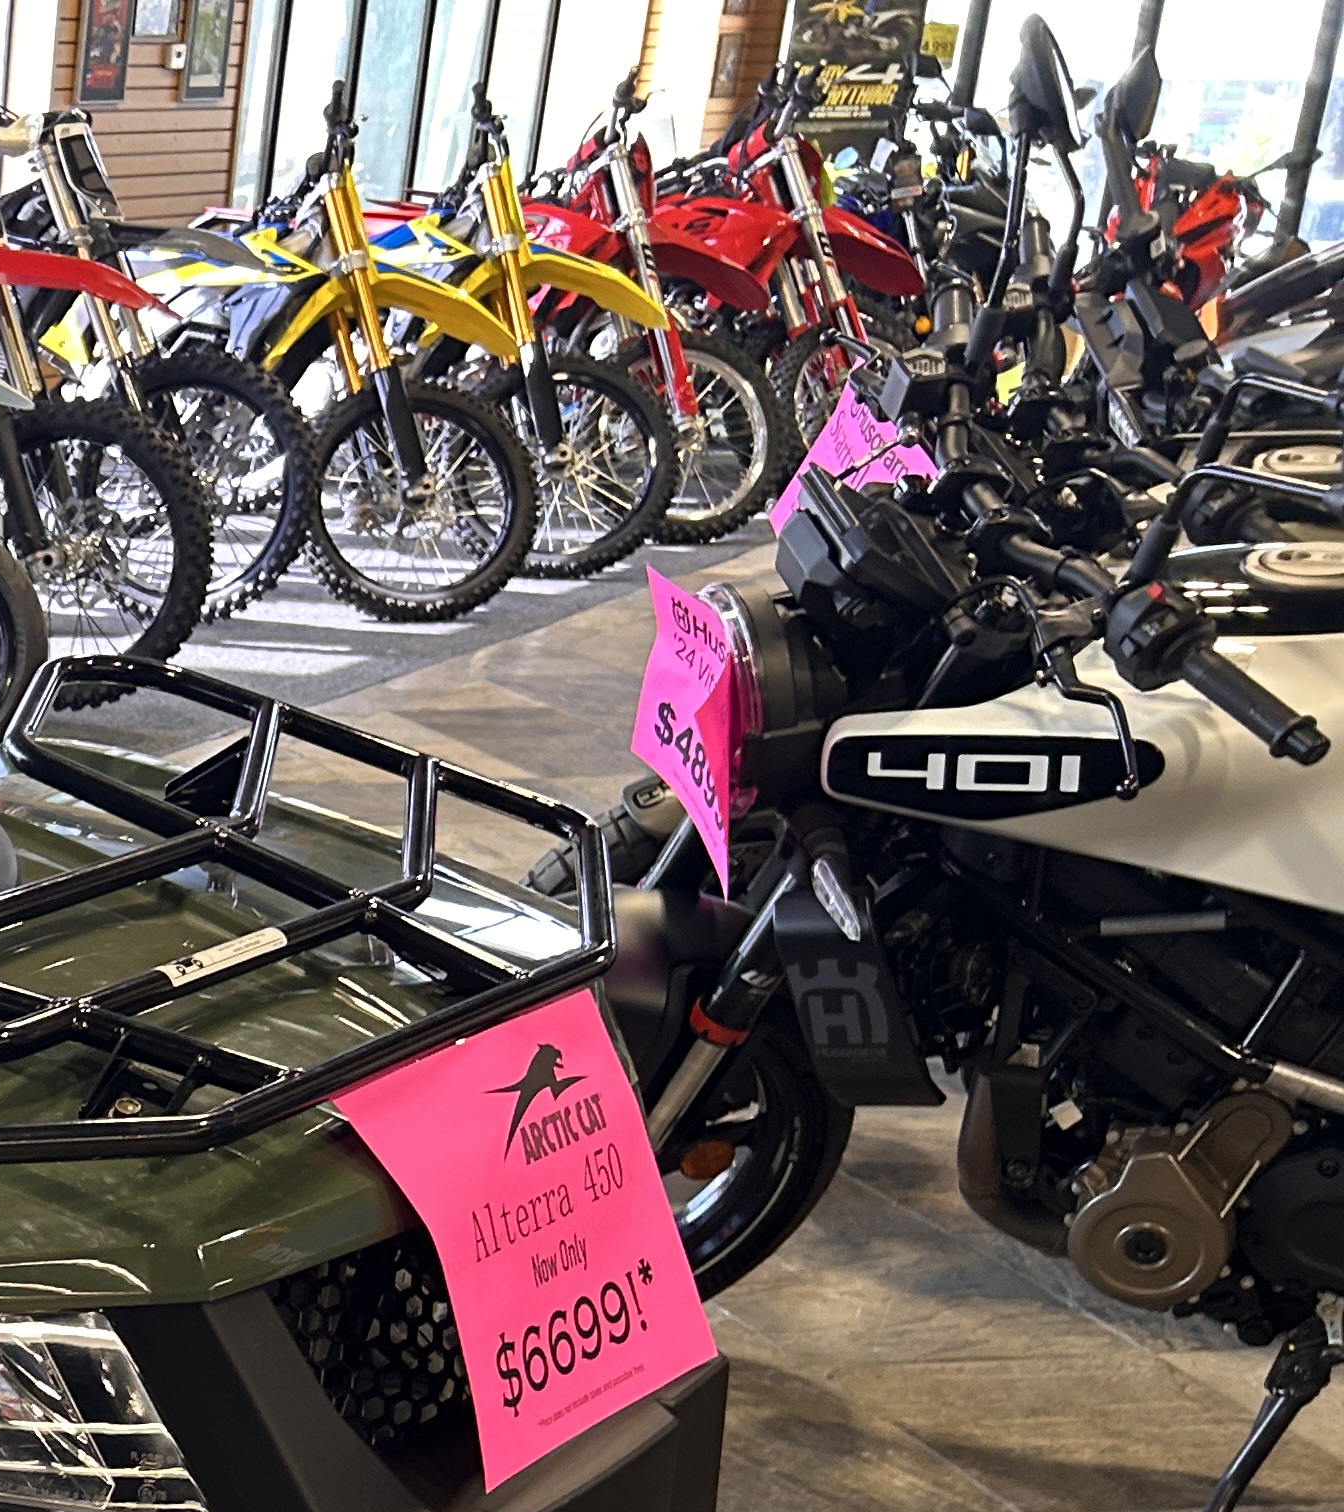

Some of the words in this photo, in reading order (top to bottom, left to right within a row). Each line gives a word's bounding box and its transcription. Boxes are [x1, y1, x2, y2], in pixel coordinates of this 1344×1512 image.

[824, 84, 899, 106] NYTHING
[693, 615, 727, 663] Hus
[698, 656, 716, 695] Vit
[867, 752, 1081, 792] 401
[520, 1106, 579, 1166] ARCTIC
[575, 1093, 607, 1136] CAT
[472, 1183, 574, 1263] Alterra
[584, 1142, 624, 1203] 450
[531, 1253, 558, 1288] Now
[559, 1233, 587, 1271] Only
